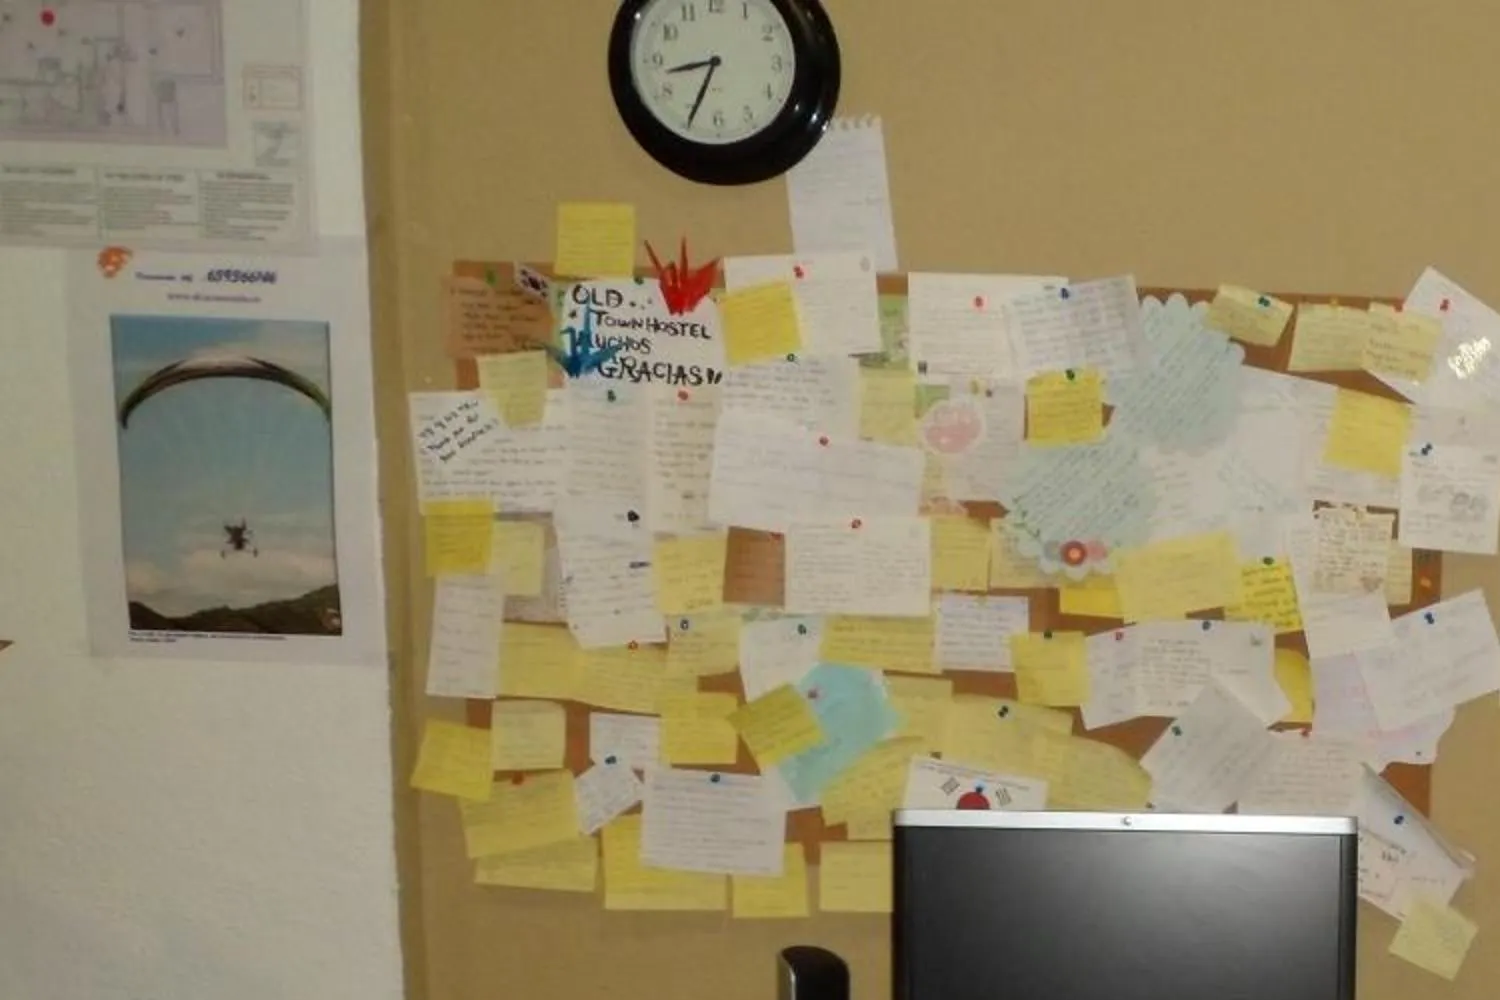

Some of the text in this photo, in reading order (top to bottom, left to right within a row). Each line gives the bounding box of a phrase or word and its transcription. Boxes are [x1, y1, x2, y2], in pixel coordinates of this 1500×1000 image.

[681, 2, 696, 21] 11
[662, 22, 679, 41] 10
[761, 23, 775, 42] 2
[652, 52, 664, 66] 9
[771, 53, 783, 73] 3
[712, 109, 725, 128] 6
[572, 284, 624, 308] OLD
